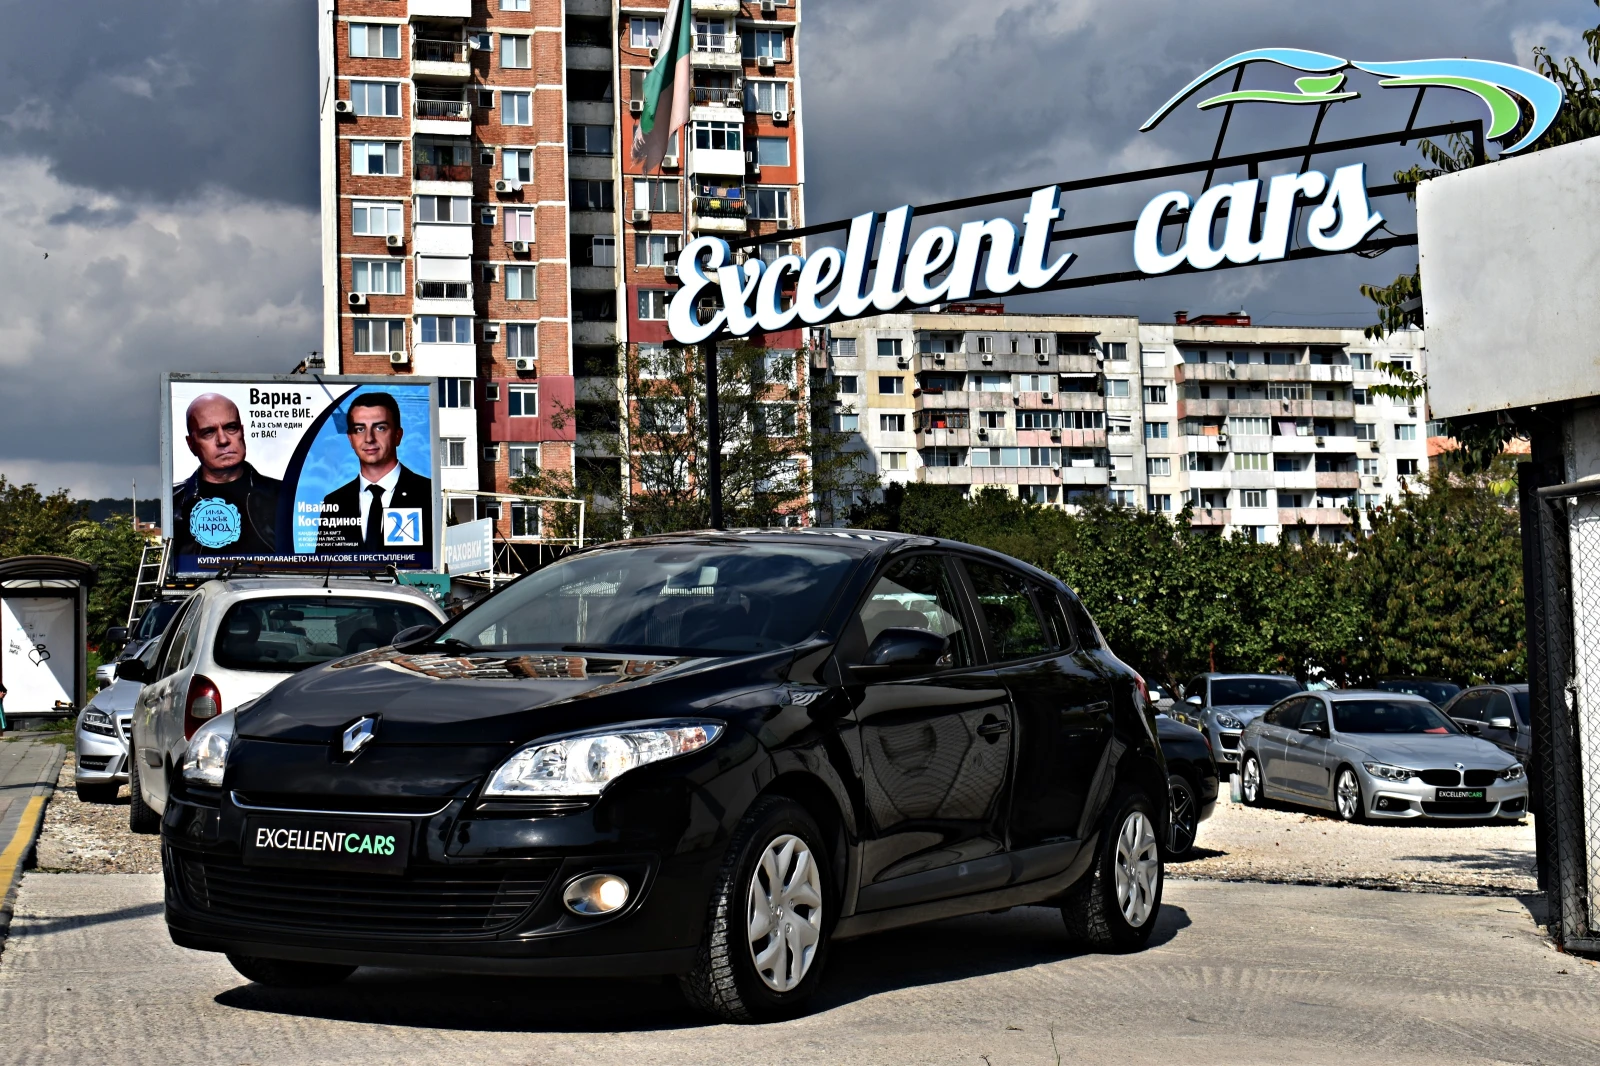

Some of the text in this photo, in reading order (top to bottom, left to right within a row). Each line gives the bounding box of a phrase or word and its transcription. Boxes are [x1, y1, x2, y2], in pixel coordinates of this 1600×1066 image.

[668, 162, 1387, 345] Excellent cars
[250, 388, 301, 409] Варна
[249, 408, 314, 418] това сте ВИЕ.
[251, 420, 256, 428] А
[261, 430, 277, 438] ВАС!
[298, 501, 339, 513] Ивайло
[298, 515, 362, 528] Костадинов
[387, 511, 420, 542] 21
[198, 523, 233, 536] НАРОД
[359, 553, 415, 561] ПРЕСТЪПЛЕНИЕ
[255, 828, 396, 856] EXCELLENTCARS
